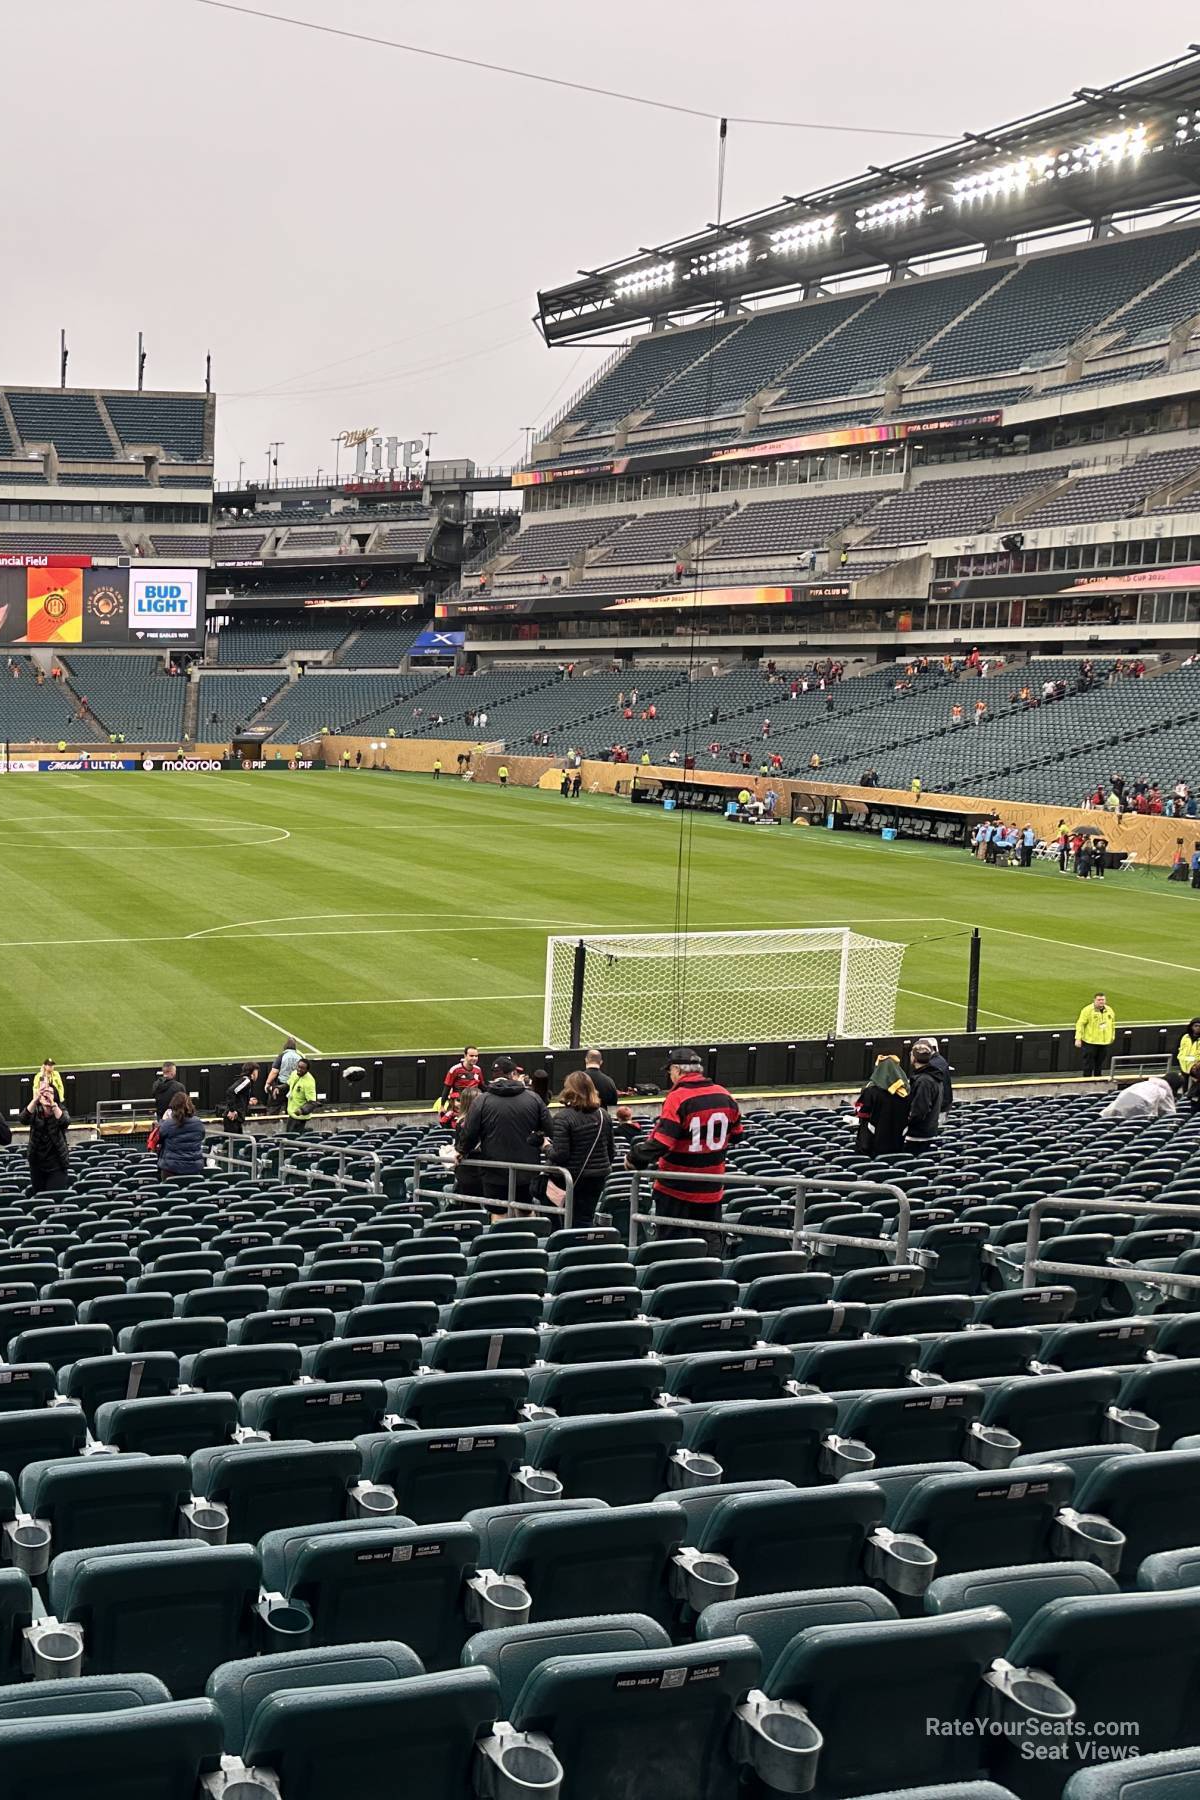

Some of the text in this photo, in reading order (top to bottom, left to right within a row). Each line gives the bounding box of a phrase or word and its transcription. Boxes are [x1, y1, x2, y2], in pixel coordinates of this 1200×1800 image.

[339, 427, 379, 448] Miller
[25, 556, 48, 566] Field
[145, 585, 182, 599] BUD
[137, 599, 188, 613] LIGHT
[90, 761, 125, 770] ULTRA
[161, 760, 222, 771] motorola
[252, 761, 266, 769] PIF
[298, 761, 313, 769] PIF
[688, 1112, 729, 1152] 10
[693, 1668, 708, 1676] SCAN
[616, 1677, 660, 1687] NEED HELP?
